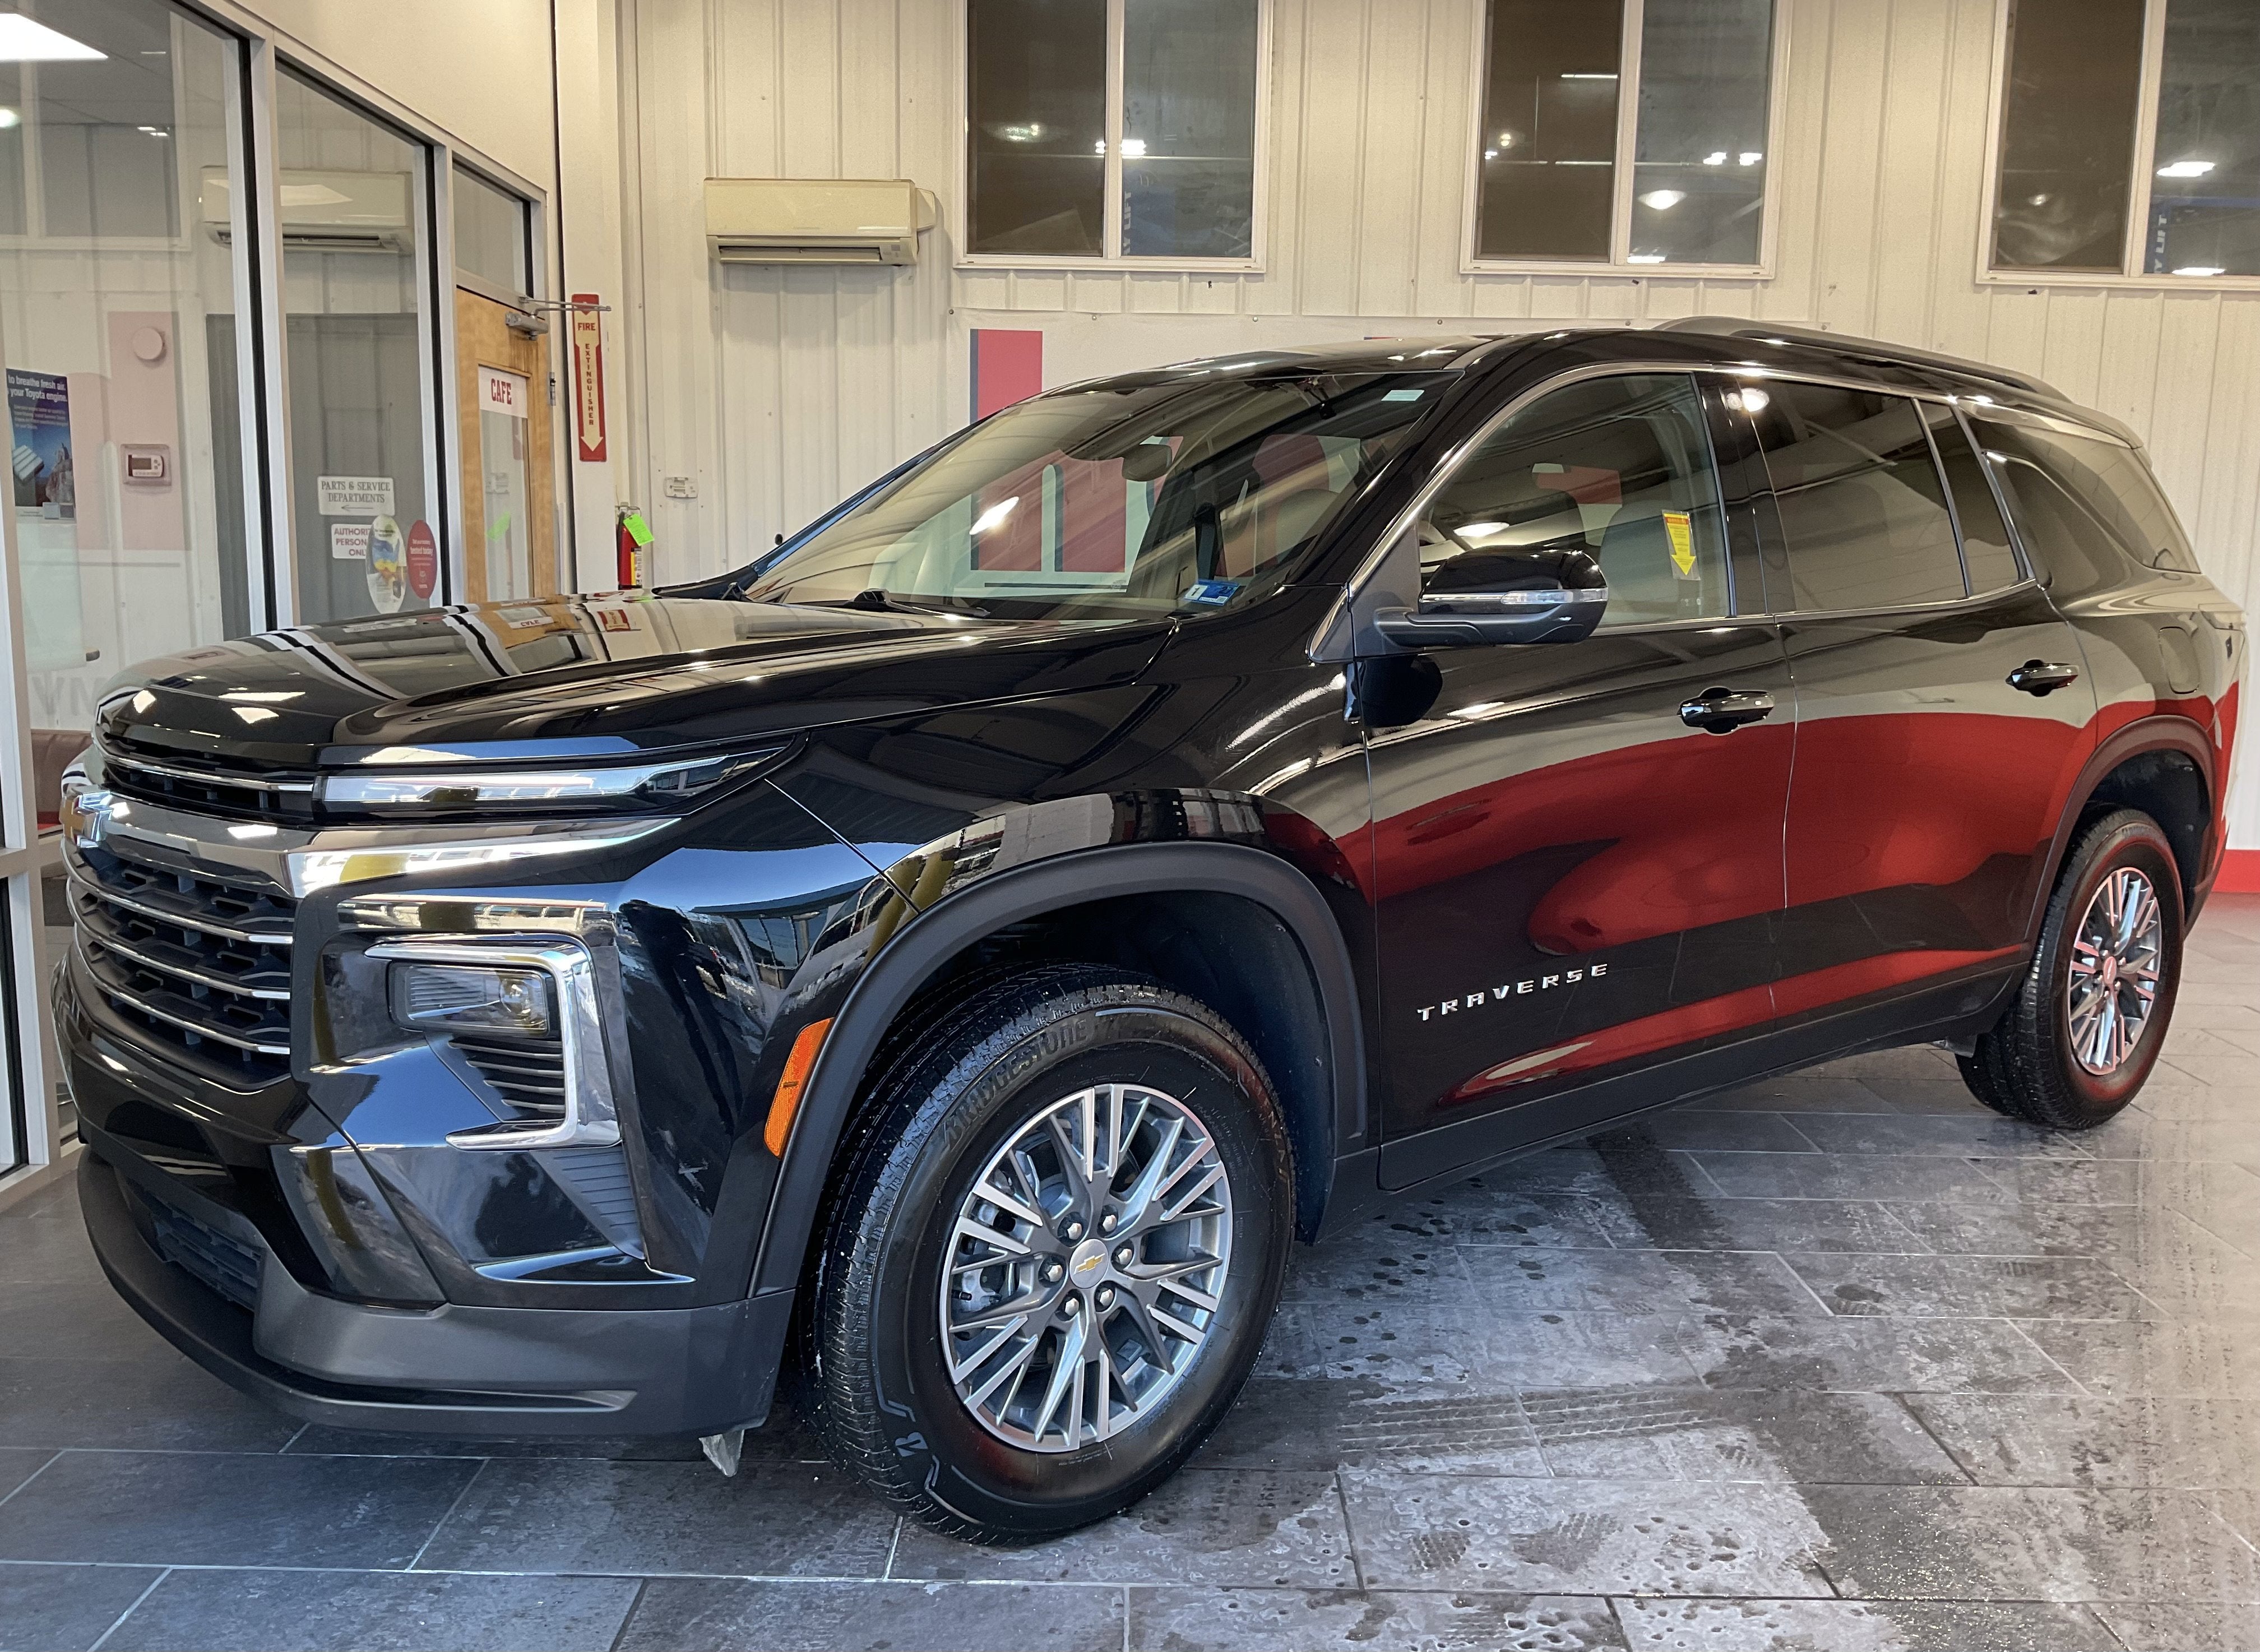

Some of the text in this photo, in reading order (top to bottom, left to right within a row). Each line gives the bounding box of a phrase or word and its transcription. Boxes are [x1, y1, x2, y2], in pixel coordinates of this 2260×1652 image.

[577, 322, 596, 331] FIRE
[8, 375, 15, 384] to
[16, 376, 40, 387] breathe
[40, 380, 56, 389] fresh
[585, 343, 595, 425] EXTINGUISHER
[10, 388, 24, 397] your
[25, 388, 45, 400] Toyota
[490, 378, 512, 405] CAFE
[321, 480, 391, 492] PARTS & SERVICE
[328, 493, 385, 503] DEPARTMENTS
[1416, 963, 1608, 1021] TRAVERSE
[944, 1017, 1087, 1147] BRIDGESTONE
